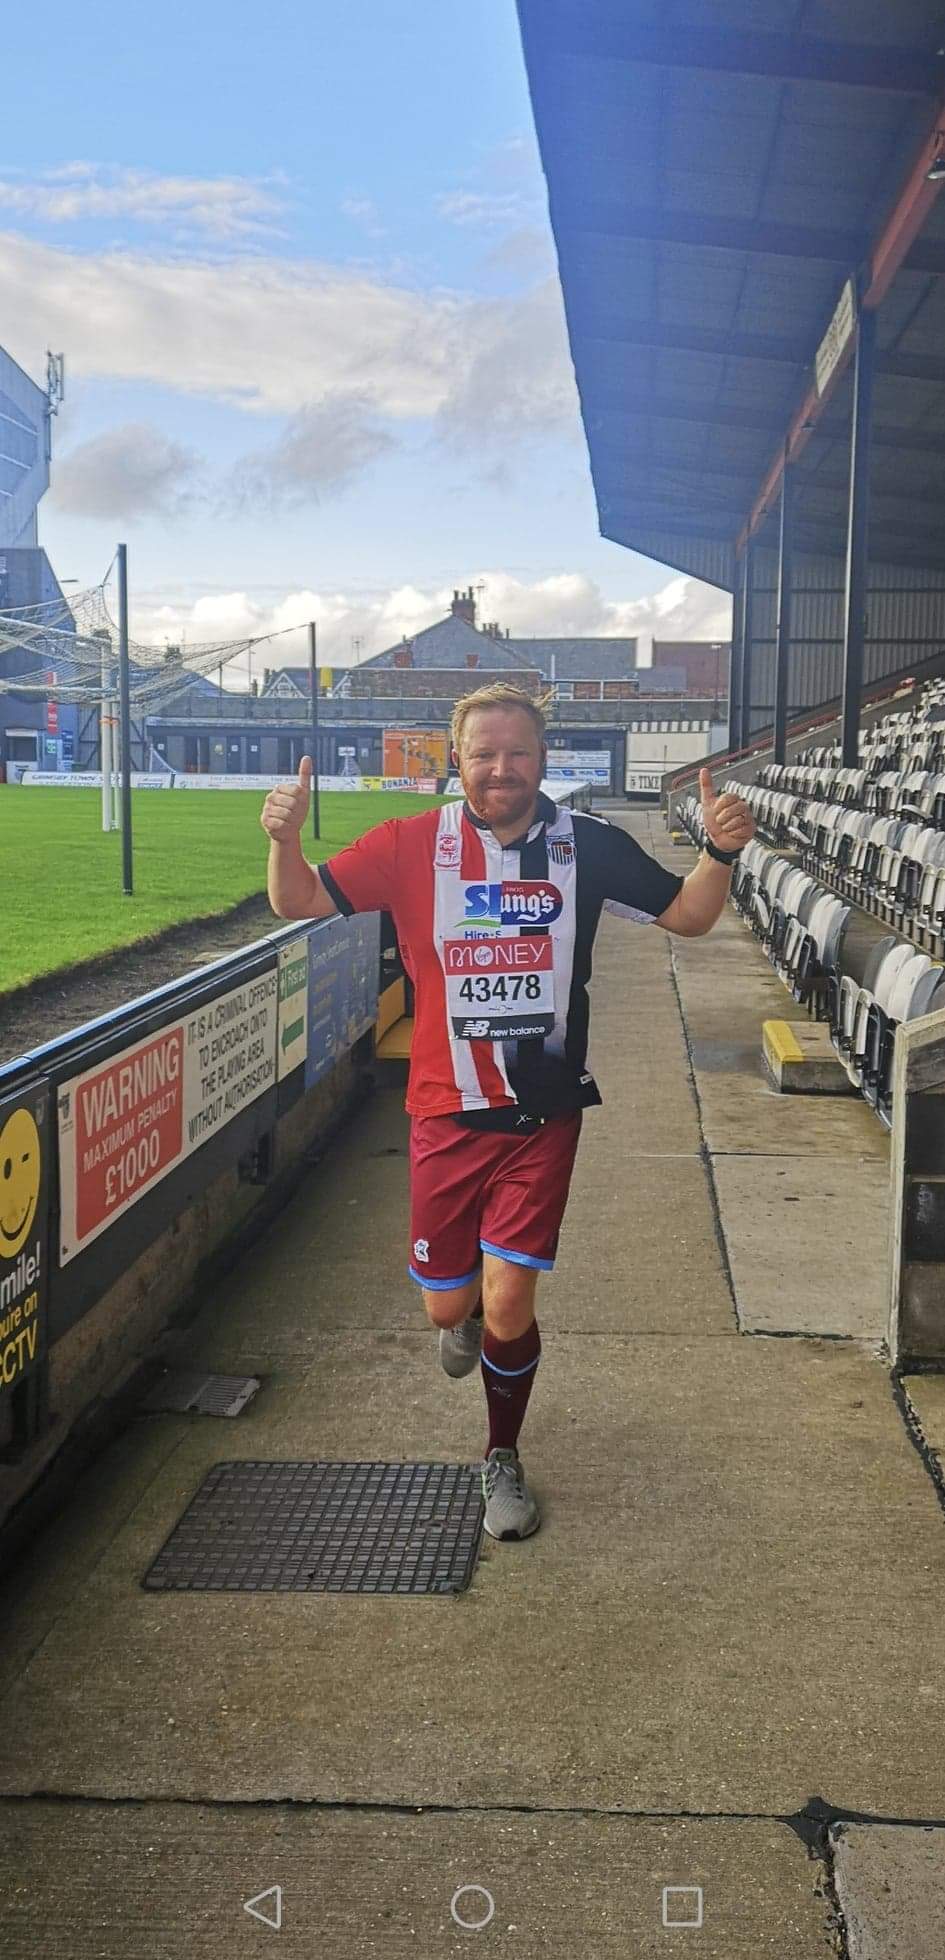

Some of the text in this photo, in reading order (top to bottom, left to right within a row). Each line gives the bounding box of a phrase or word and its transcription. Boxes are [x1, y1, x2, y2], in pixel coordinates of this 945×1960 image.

[449, 943, 548, 968] MONEY
[214, 991, 247, 1029] CRIMINAL
[248, 976, 277, 1010] OFFENCE
[459, 974, 541, 1003] 43478
[199, 1045, 210, 1070] TO
[211, 1020, 249, 1062] ENCROACH
[490, 1029, 509, 1038] new
[509, 1025, 546, 1036] balance
[82, 1036, 180, 1139] WARNING
[201, 1037, 265, 1100] THE PLAYING AREA
[188, 1056, 274, 1144] WITHOUT AUTHORISATION
[83, 1087, 178, 1174] MAXIMUM PENALTY
[104, 1128, 160, 1208] £1000
[24, 1291, 38, 1318] on
